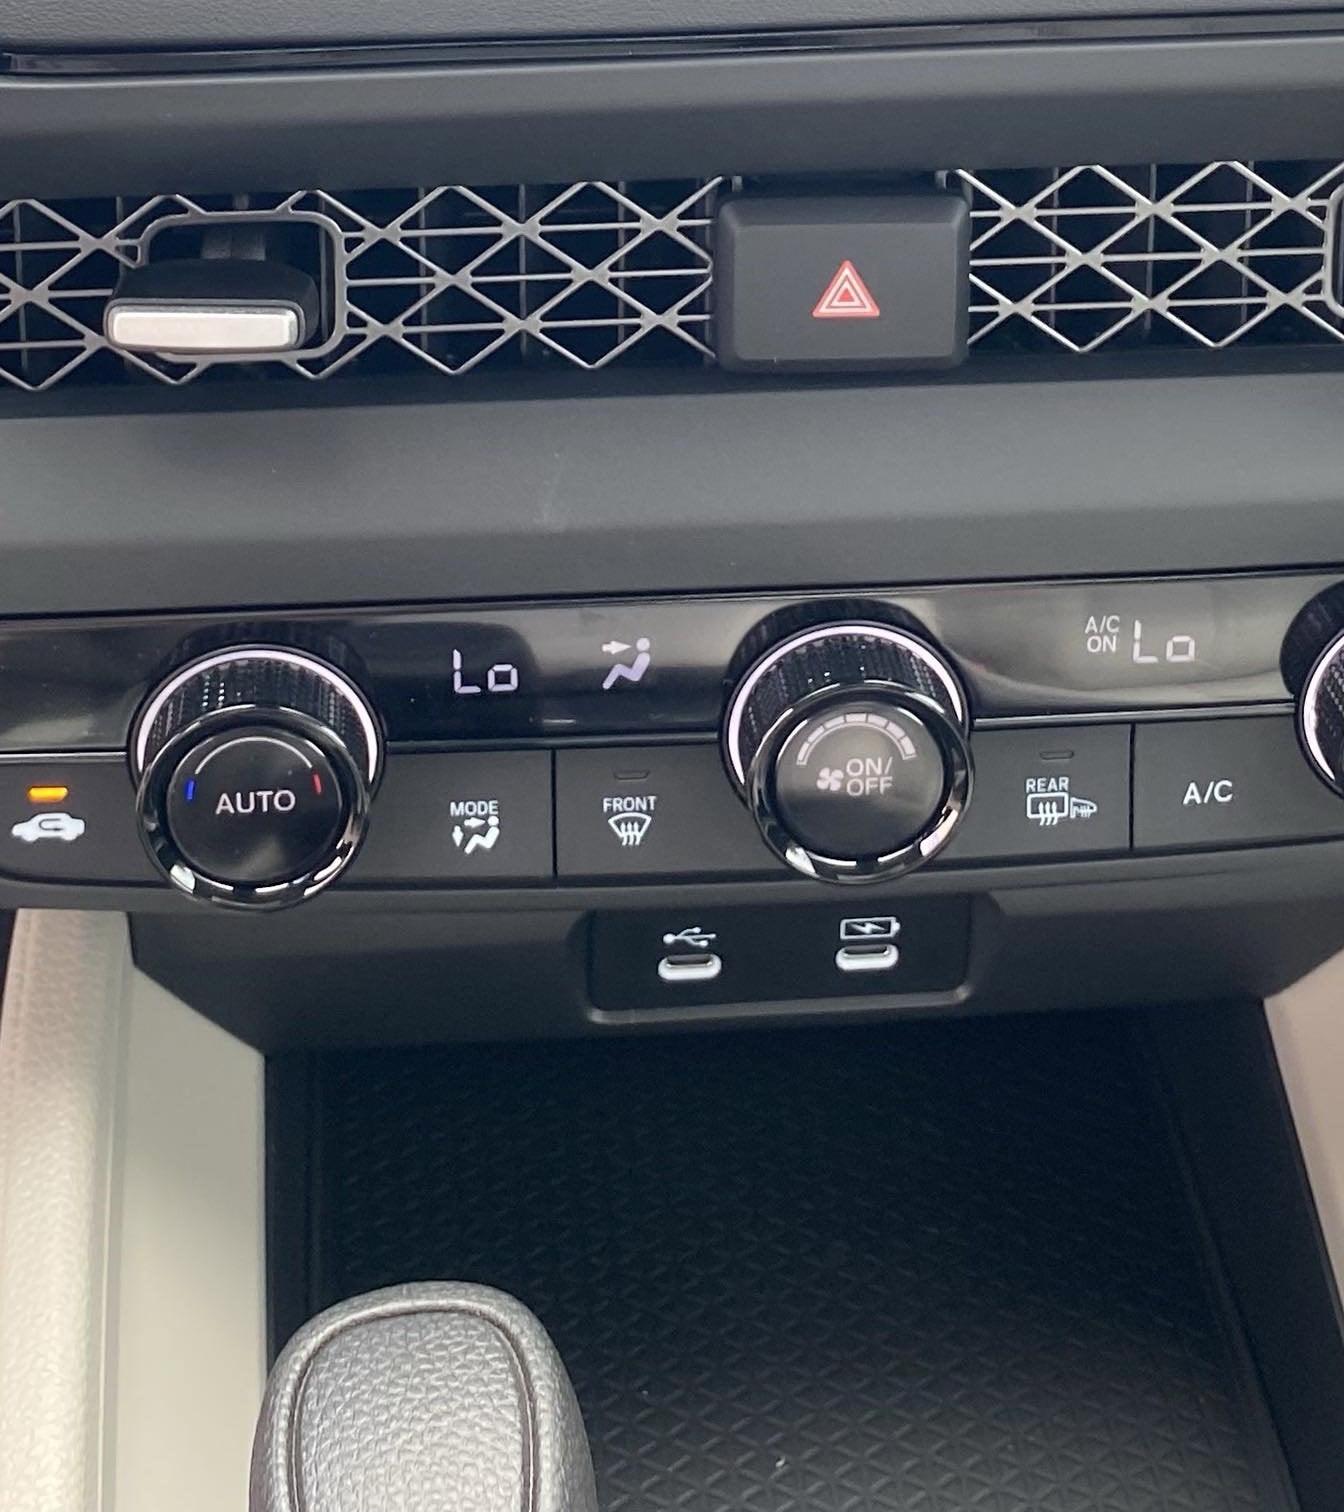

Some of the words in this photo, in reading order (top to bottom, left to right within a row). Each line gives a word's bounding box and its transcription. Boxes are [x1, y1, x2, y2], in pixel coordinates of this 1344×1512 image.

[1085, 615, 1120, 633] A/C
[1086, 635, 1117, 652] ON
[452, 649, 518, 694] Lo
[846, 757, 893, 776] ON/
[846, 775, 893, 797] OFF
[1025, 777, 1069, 792] REAR
[1182, 780, 1233, 805] A/C
[215, 790, 296, 815] AUTO
[450, 801, 498, 816] MODE
[603, 797, 656, 812] FRONT
